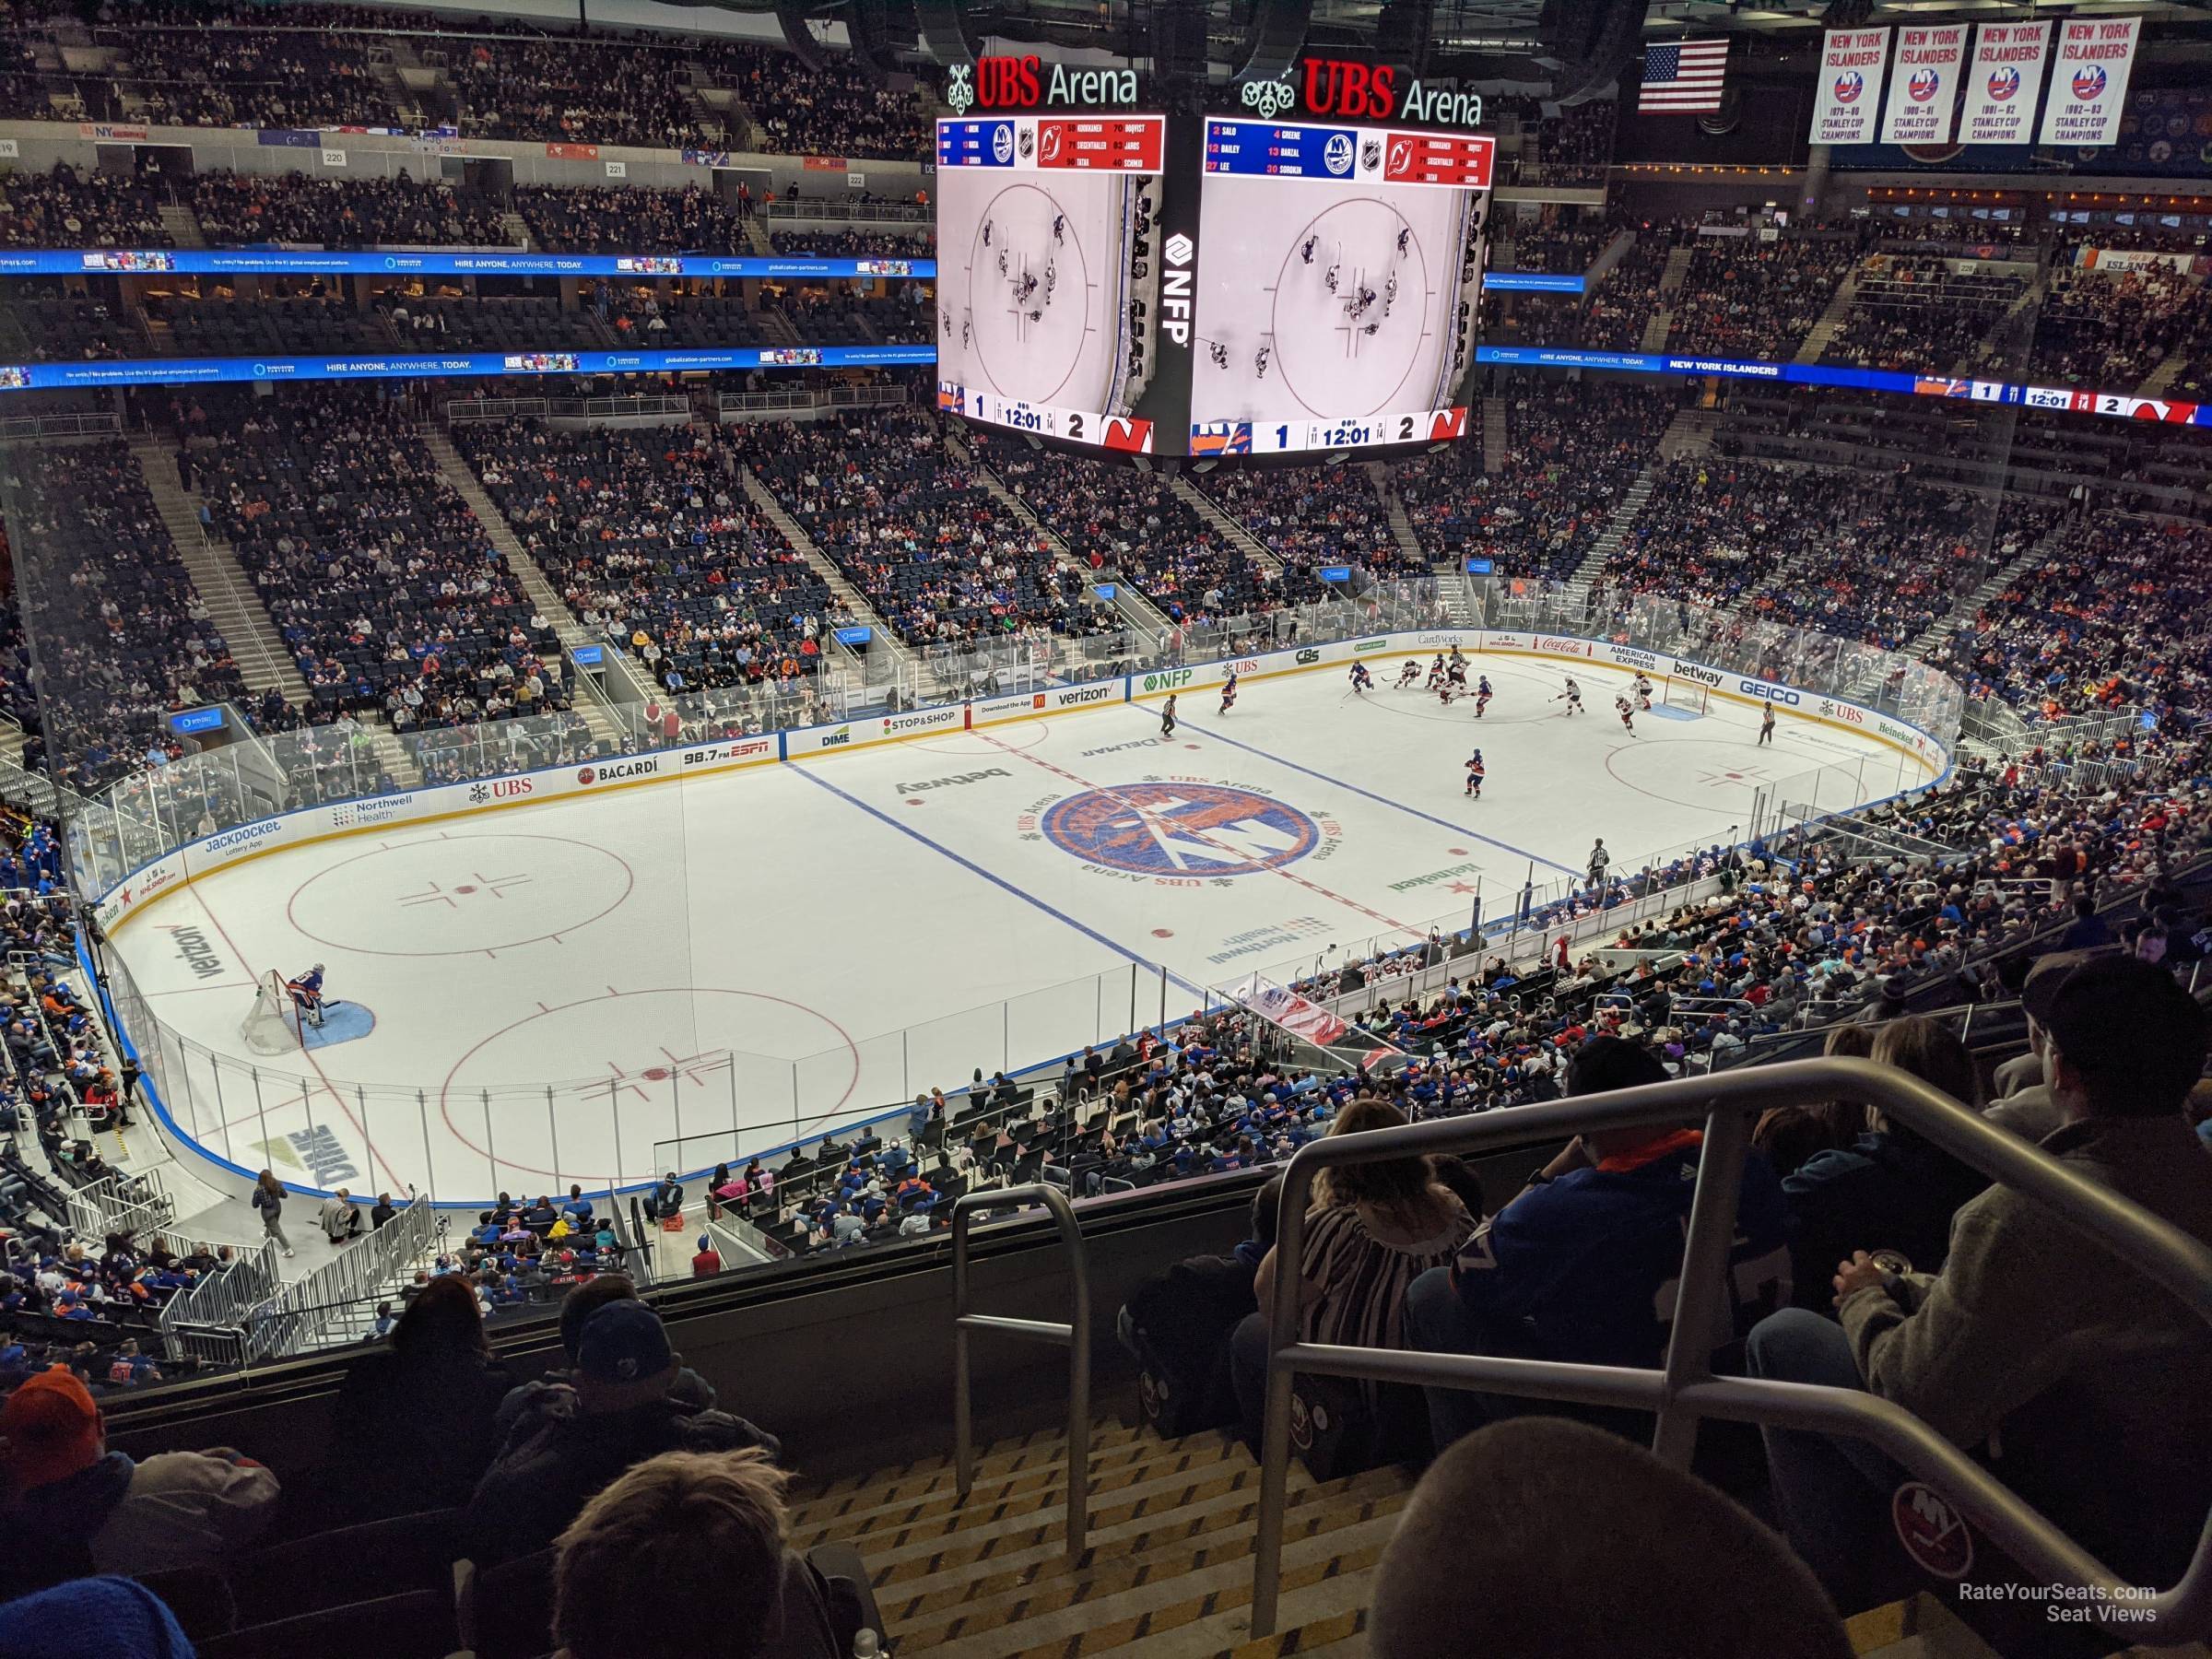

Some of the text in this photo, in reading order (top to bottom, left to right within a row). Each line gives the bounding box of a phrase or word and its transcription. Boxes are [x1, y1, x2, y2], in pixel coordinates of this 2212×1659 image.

[1904, 29, 1960, 45] NEW YORK
[1983, 27, 2043, 43] NEW YORK
[2067, 23, 2132, 40] NEW YORK
[1830, 33, 1882, 49] NEW YORK
[1827, 51, 1881, 66] ISLANDERS
[1900, 49, 1958, 65] ISLANDERS
[1979, 46, 2041, 62] ISLANDERS
[2062, 43, 2129, 60] ISLANDERS
[977, 55, 1137, 108] UBS Arena
[1303, 58, 1482, 126] UBS Arena
[1821, 119, 1865, 128] STANLEY CUP
[1893, 118, 1939, 128] STANLEY CUP
[1971, 117, 2020, 127] STANLEY CUP
[2055, 117, 2108, 127] STANLEY CUP
[95, 126, 112, 137] NY
[1222, 126, 1236, 135] SALO
[1821, 130, 1861, 139] CHAMPIONS
[1894, 130, 1935, 139] CHAMPIONS
[1971, 130, 2017, 139] CHAMPIONS
[2055, 130, 2102, 140] CHAMPIONS
[1208, 144, 1218, 153] 12
[1220, 145, 1240, 153] BAILEY
[326, 153, 342, 162] 220
[1220, 162, 1230, 171] LEE
[476, 260, 509, 268] ANYONE,
[1162, 270, 1192, 344] NFP
[326, 363, 347, 371] HIRE
[349, 362, 388, 371] ANYONE,
[441, 361, 471, 370] TODAY.
[665, 356, 732, 364] globalization-partners.com
[1669, 359, 1778, 375] NEW YORK ISLANDERS
[1983, 385, 1992, 397] 1
[976, 395, 983, 417] 1
[2030, 394, 2066, 407] 12:01
[2077, 399, 2088, 411] 14
[2104, 399, 2119, 412] 2
[1006, 408, 1041, 430] 12:01
[1068, 414, 1084, 438] 2
[1324, 427, 1370, 446] 12:01
[1398, 417, 1414, 440] 2
[1276, 425, 1288, 449] 1
[1418, 634, 1464, 645] CardWorks
[1542, 637, 1582, 654] Coca-Cola
[1610, 647, 1656, 663] AMERICAN
[1615, 655, 1655, 671] EXPRESS
[1235, 659, 1258, 674] UBS
[1674, 661, 1724, 688] betway
[1159, 669, 1193, 691] NFP
[1059, 688, 1107, 706] verizon
[1739, 681, 1801, 706] GEICO
[982, 700, 1031, 714] Download the App
[1836, 704, 1865, 724] UBS
[892, 712, 955, 730] STOP&SHOP
[822, 733, 850, 747] DIME
[1878, 722, 1913, 746] Heineken
[684, 741, 769, 765] 98.7 FM ESPN
[599, 756, 658, 781] BACARDÍ
[492, 777, 533, 798] UBS
[896, 768, 1014, 795] betway
[1170, 774, 1274, 795] UBS Arena
[357, 795, 413, 812] Northwell
[358, 811, 393, 823] Health
[1018, 793, 1062, 831] UBS Arena
[225, 840, 263, 857] Lottery App
[1312, 820, 1342, 862] UBS Arena
[1081, 864, 1203, 888] UBS Arena
[1387, 863, 1488, 893] Heineken
[1222, 925, 1284, 946] Health
[170, 924, 225, 981] verizon
[1206, 934, 1300, 964] Northwell
[287, 1124, 360, 1187] DIME
